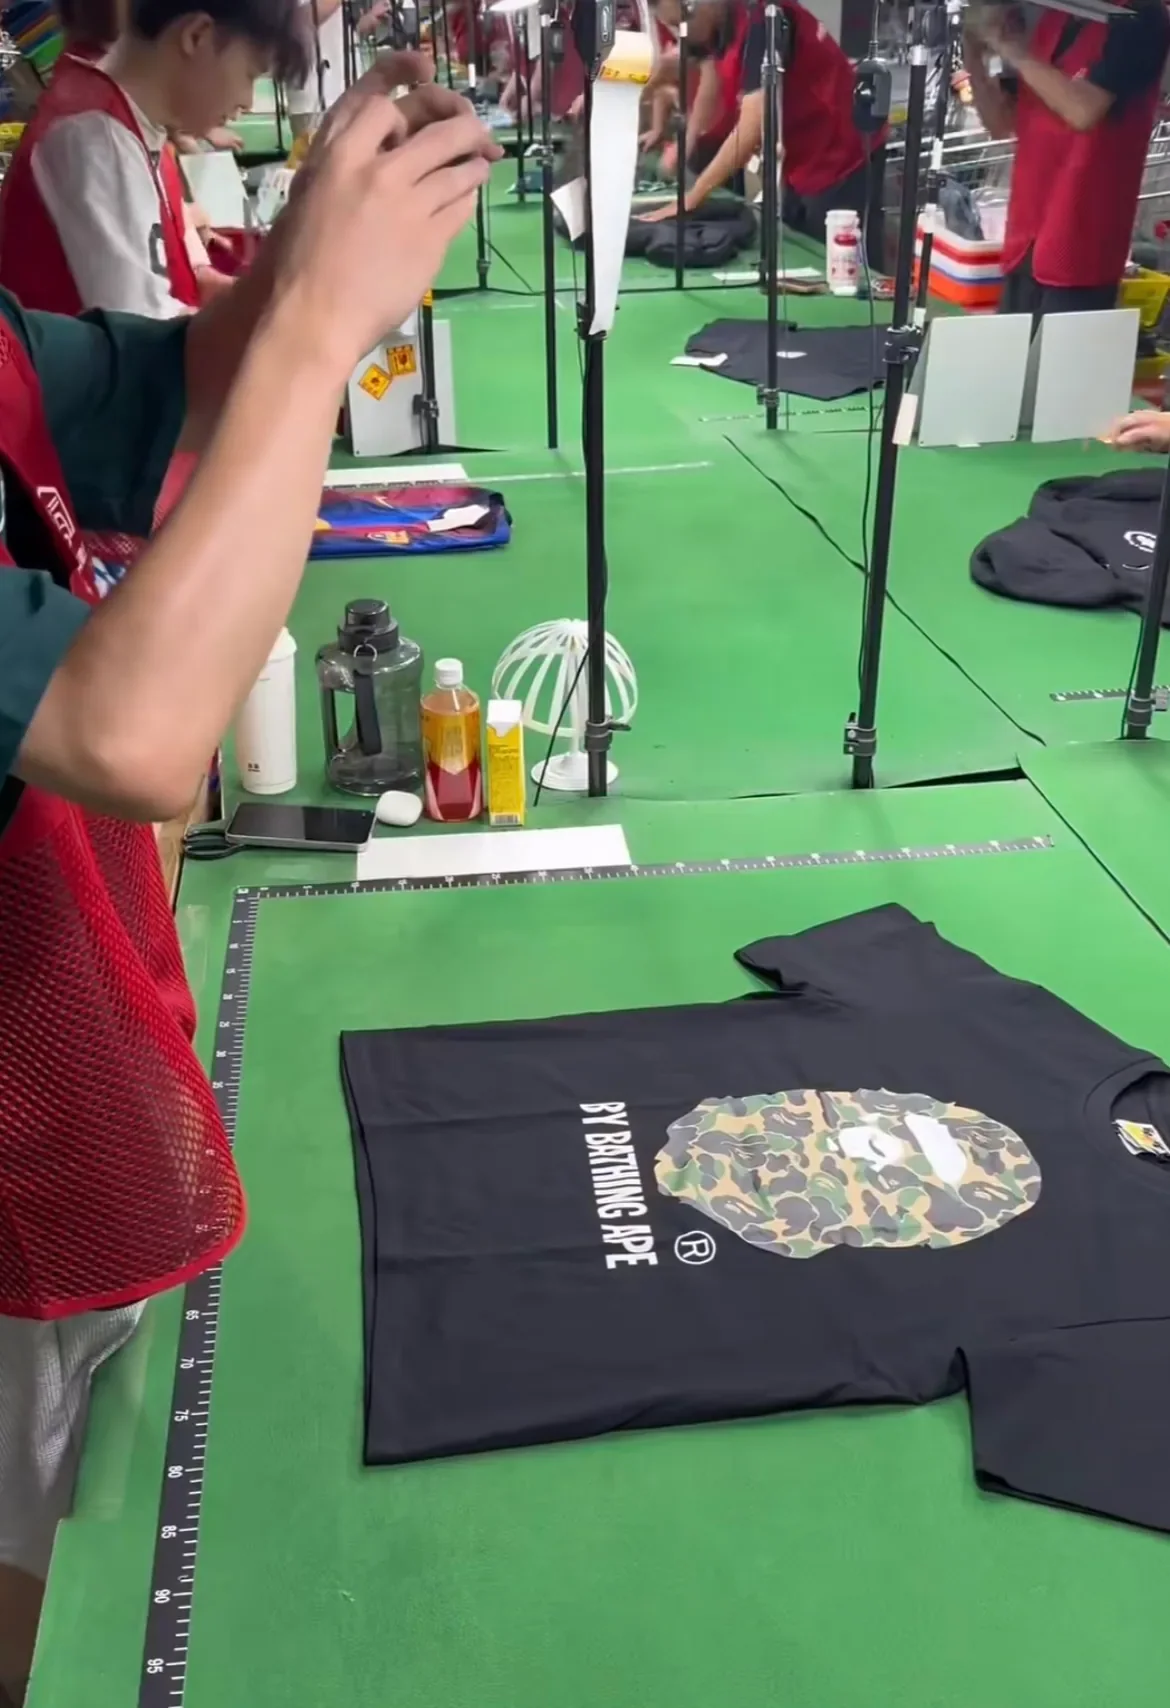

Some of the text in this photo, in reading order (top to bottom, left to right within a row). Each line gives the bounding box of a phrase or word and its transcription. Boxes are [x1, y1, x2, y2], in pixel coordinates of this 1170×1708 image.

[580, 1102, 658, 1269] BY BATHING APE
[186, 1310, 199, 1320] 65
[180, 1358, 194, 1368] 70
[174, 1410, 189, 1421] 75
[168, 1466, 183, 1478] 80
[161, 1525, 177, 1538] 85
[154, 1589, 170, 1603] 90
[147, 1658, 164, 1673] 95
